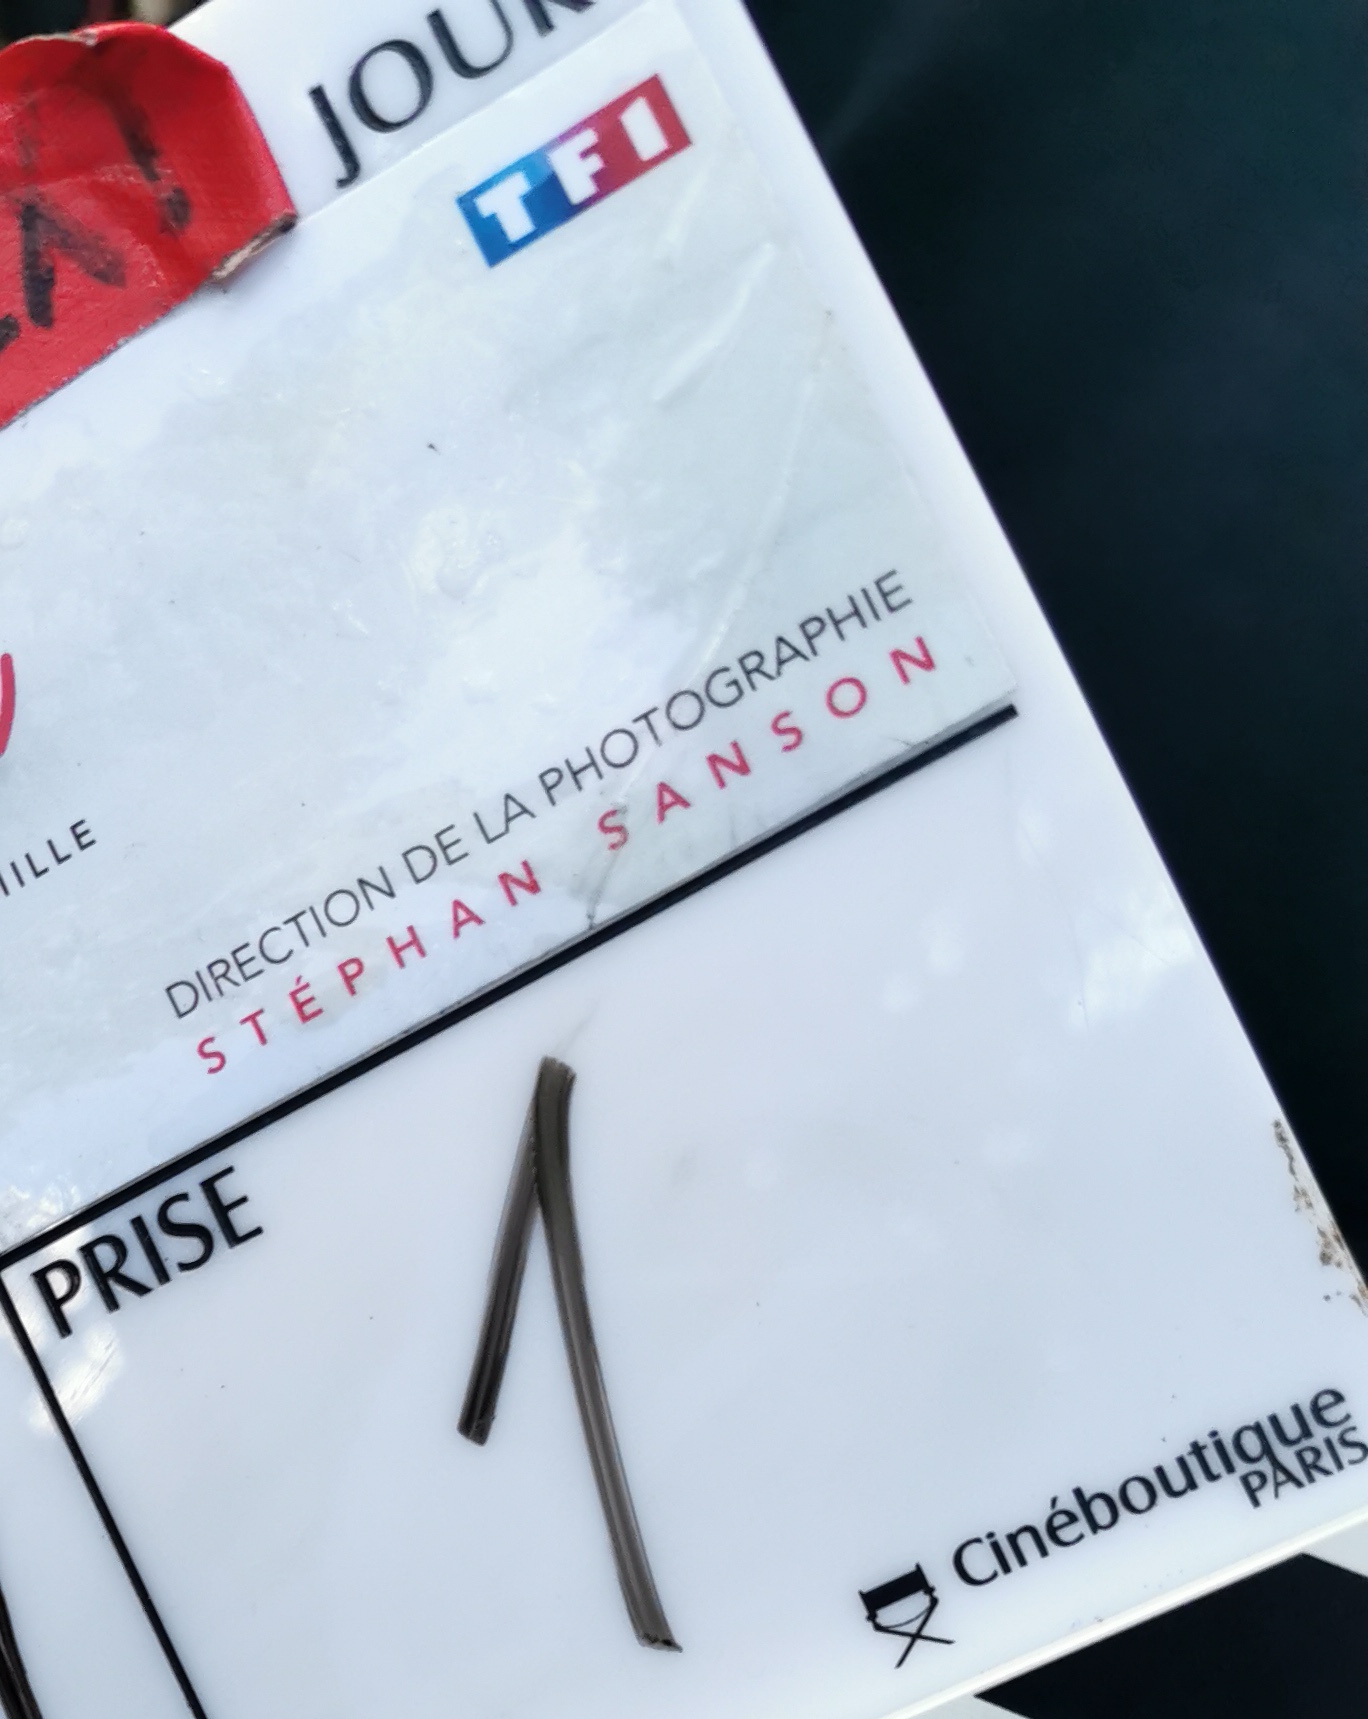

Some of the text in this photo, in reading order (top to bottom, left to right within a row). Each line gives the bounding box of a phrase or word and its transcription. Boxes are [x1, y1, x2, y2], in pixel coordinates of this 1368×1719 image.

[164, 568, 914, 1020] DIRECTION DE LA PHOTOGRAPHIE
[196, 634, 938, 1075] STÉPHAN SANSON
[30, 1165, 264, 1340] PRISE
[456, 1055, 684, 1653] 1
[951, 1385, 1353, 1589] Cinéboutique
[1238, 1424, 1368, 1510] PARIS
